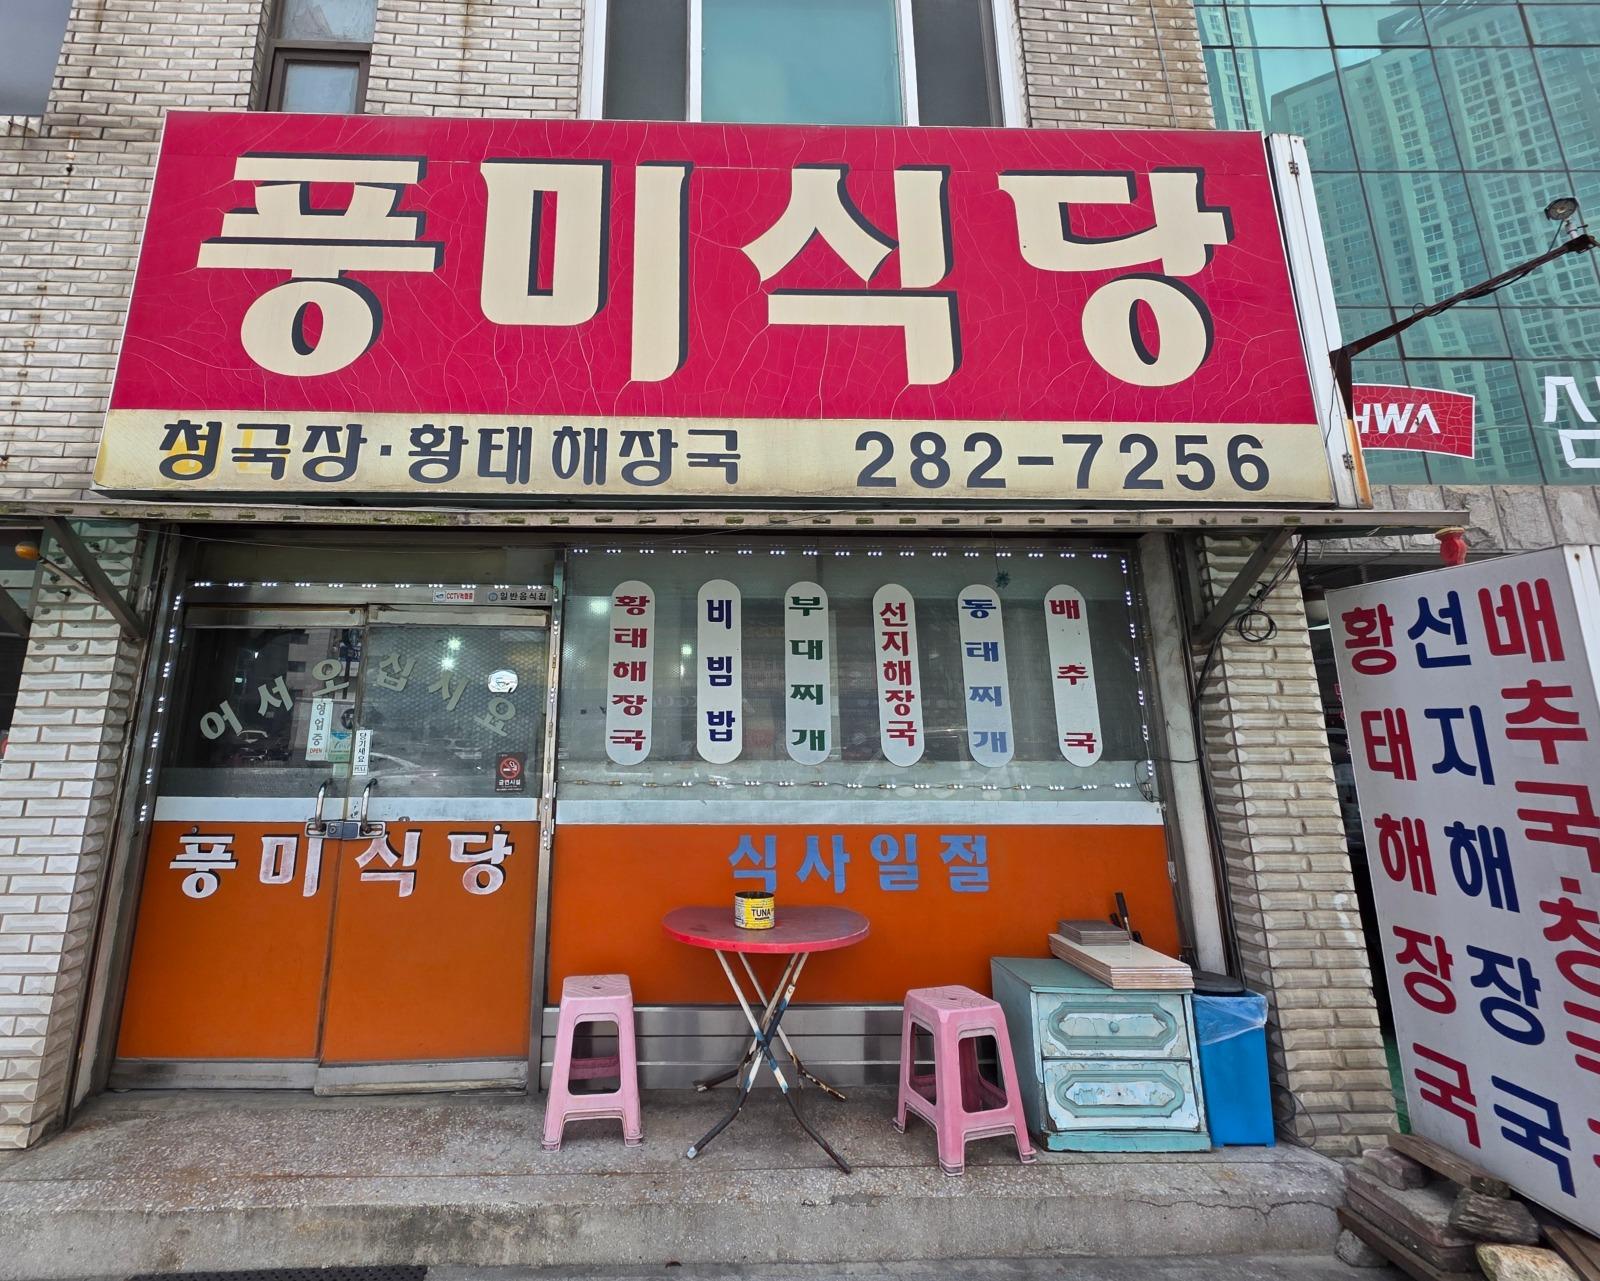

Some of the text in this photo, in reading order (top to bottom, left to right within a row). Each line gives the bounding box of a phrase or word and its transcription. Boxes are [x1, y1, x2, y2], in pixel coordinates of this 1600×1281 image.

[196, 153, 1234, 387] 풍미식당
[158, 420, 741, 486] 청국장·황태해장국
[854, 431, 1269, 491] 282-7256
[500, 591, 546, 601] 일반음식점
[312, 702, 326, 746] 영업중
[610, 595, 650, 751] 황태해장국
[706, 599, 736, 742] 비빔밥
[788, 596, 826, 751] 부대찌개
[880, 602, 917, 747] 선지해장국
[961, 599, 1008, 753] 동태찌개
[1049, 599, 1097, 754] 배추국
[357, 732, 367, 763] 당기세요
[170, 831, 514, 899] 풍미식당
[751, 908, 771, 917] TUNA
[1341, 603, 1481, 1149] 황태해장국
[1406, 590, 1577, 1198] 선지해장국
